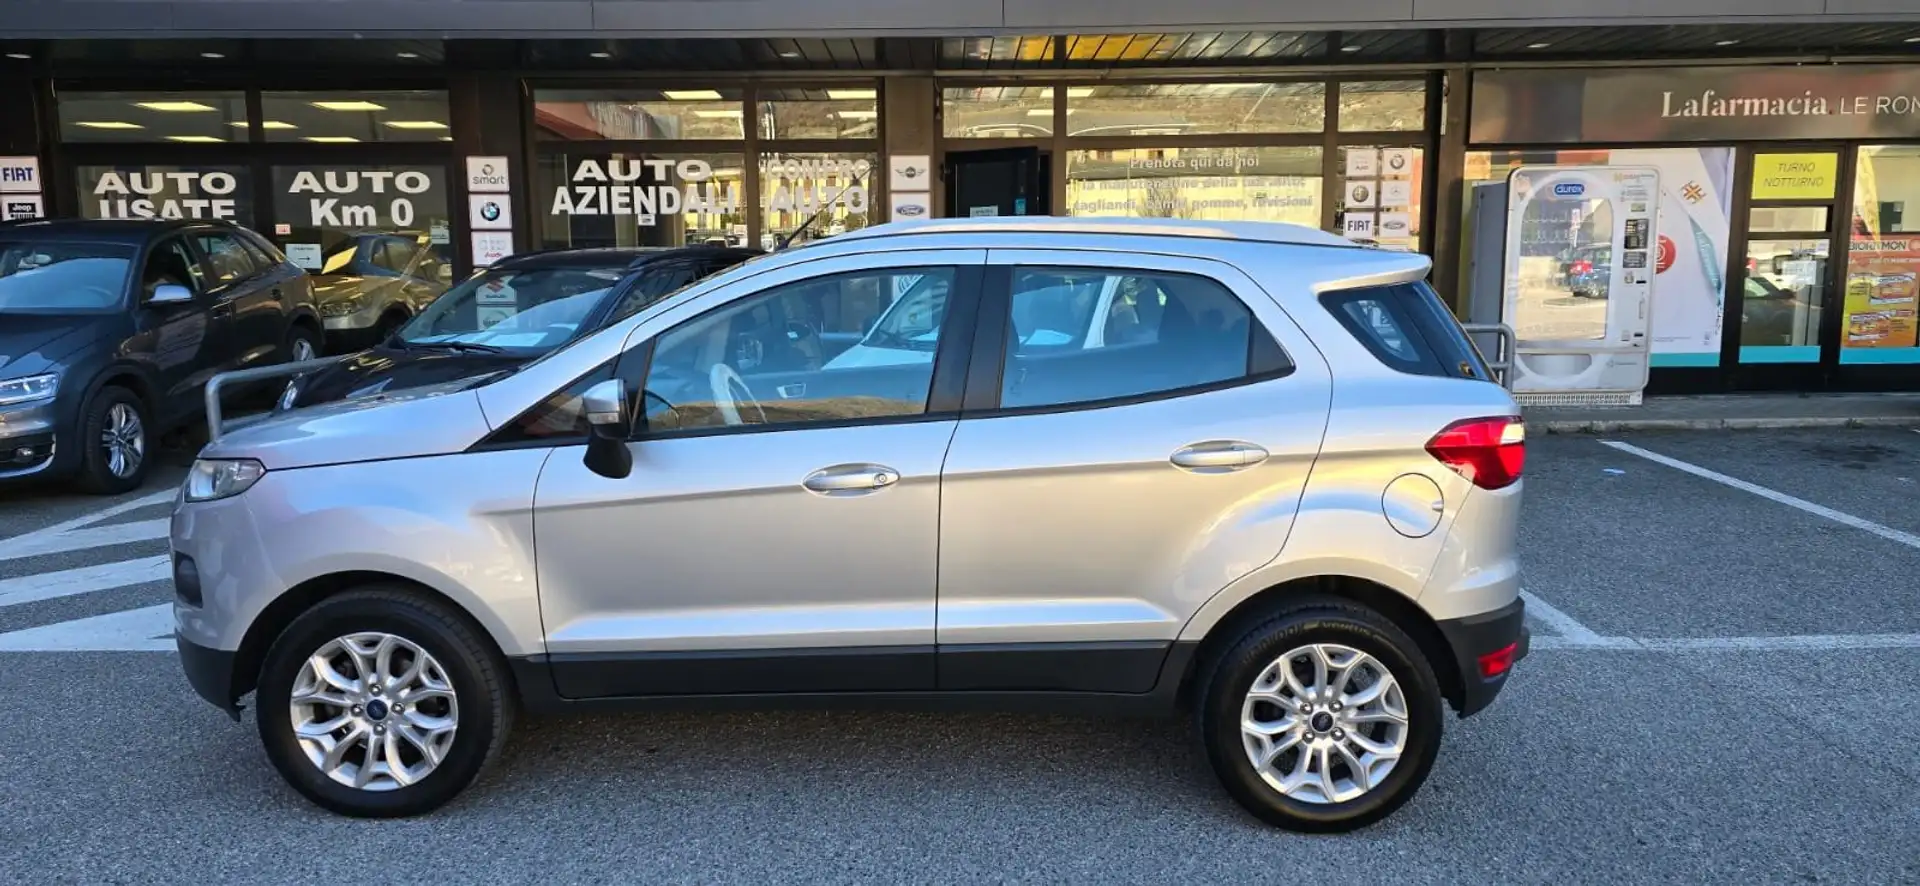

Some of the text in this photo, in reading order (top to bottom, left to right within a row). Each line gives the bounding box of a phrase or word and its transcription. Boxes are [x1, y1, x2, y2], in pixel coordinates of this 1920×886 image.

[1840, 97, 1868, 115] LE
[573, 159, 712, 182] AUTO
[766, 159, 871, 180] COMPRO
[1130, 156, 1260, 170] Prenota qui da noi
[1778, 162, 1816, 173] TURNO
[3, 167, 34, 182] FIAT
[93, 171, 236, 195] AUTO
[288, 171, 431, 194] AUTO
[472, 175, 506, 185] smart
[1762, 176, 1824, 188] NOTTURNO
[1556, 184, 1583, 194] durex
[551, 185, 737, 215] AZIENDALI
[770, 185, 869, 214] AUTO
[12, 203, 32, 215] Jeep
[98, 198, 236, 220] USATE
[310, 197, 414, 227] Km 0
[1347, 220, 1371, 232] FIAT
